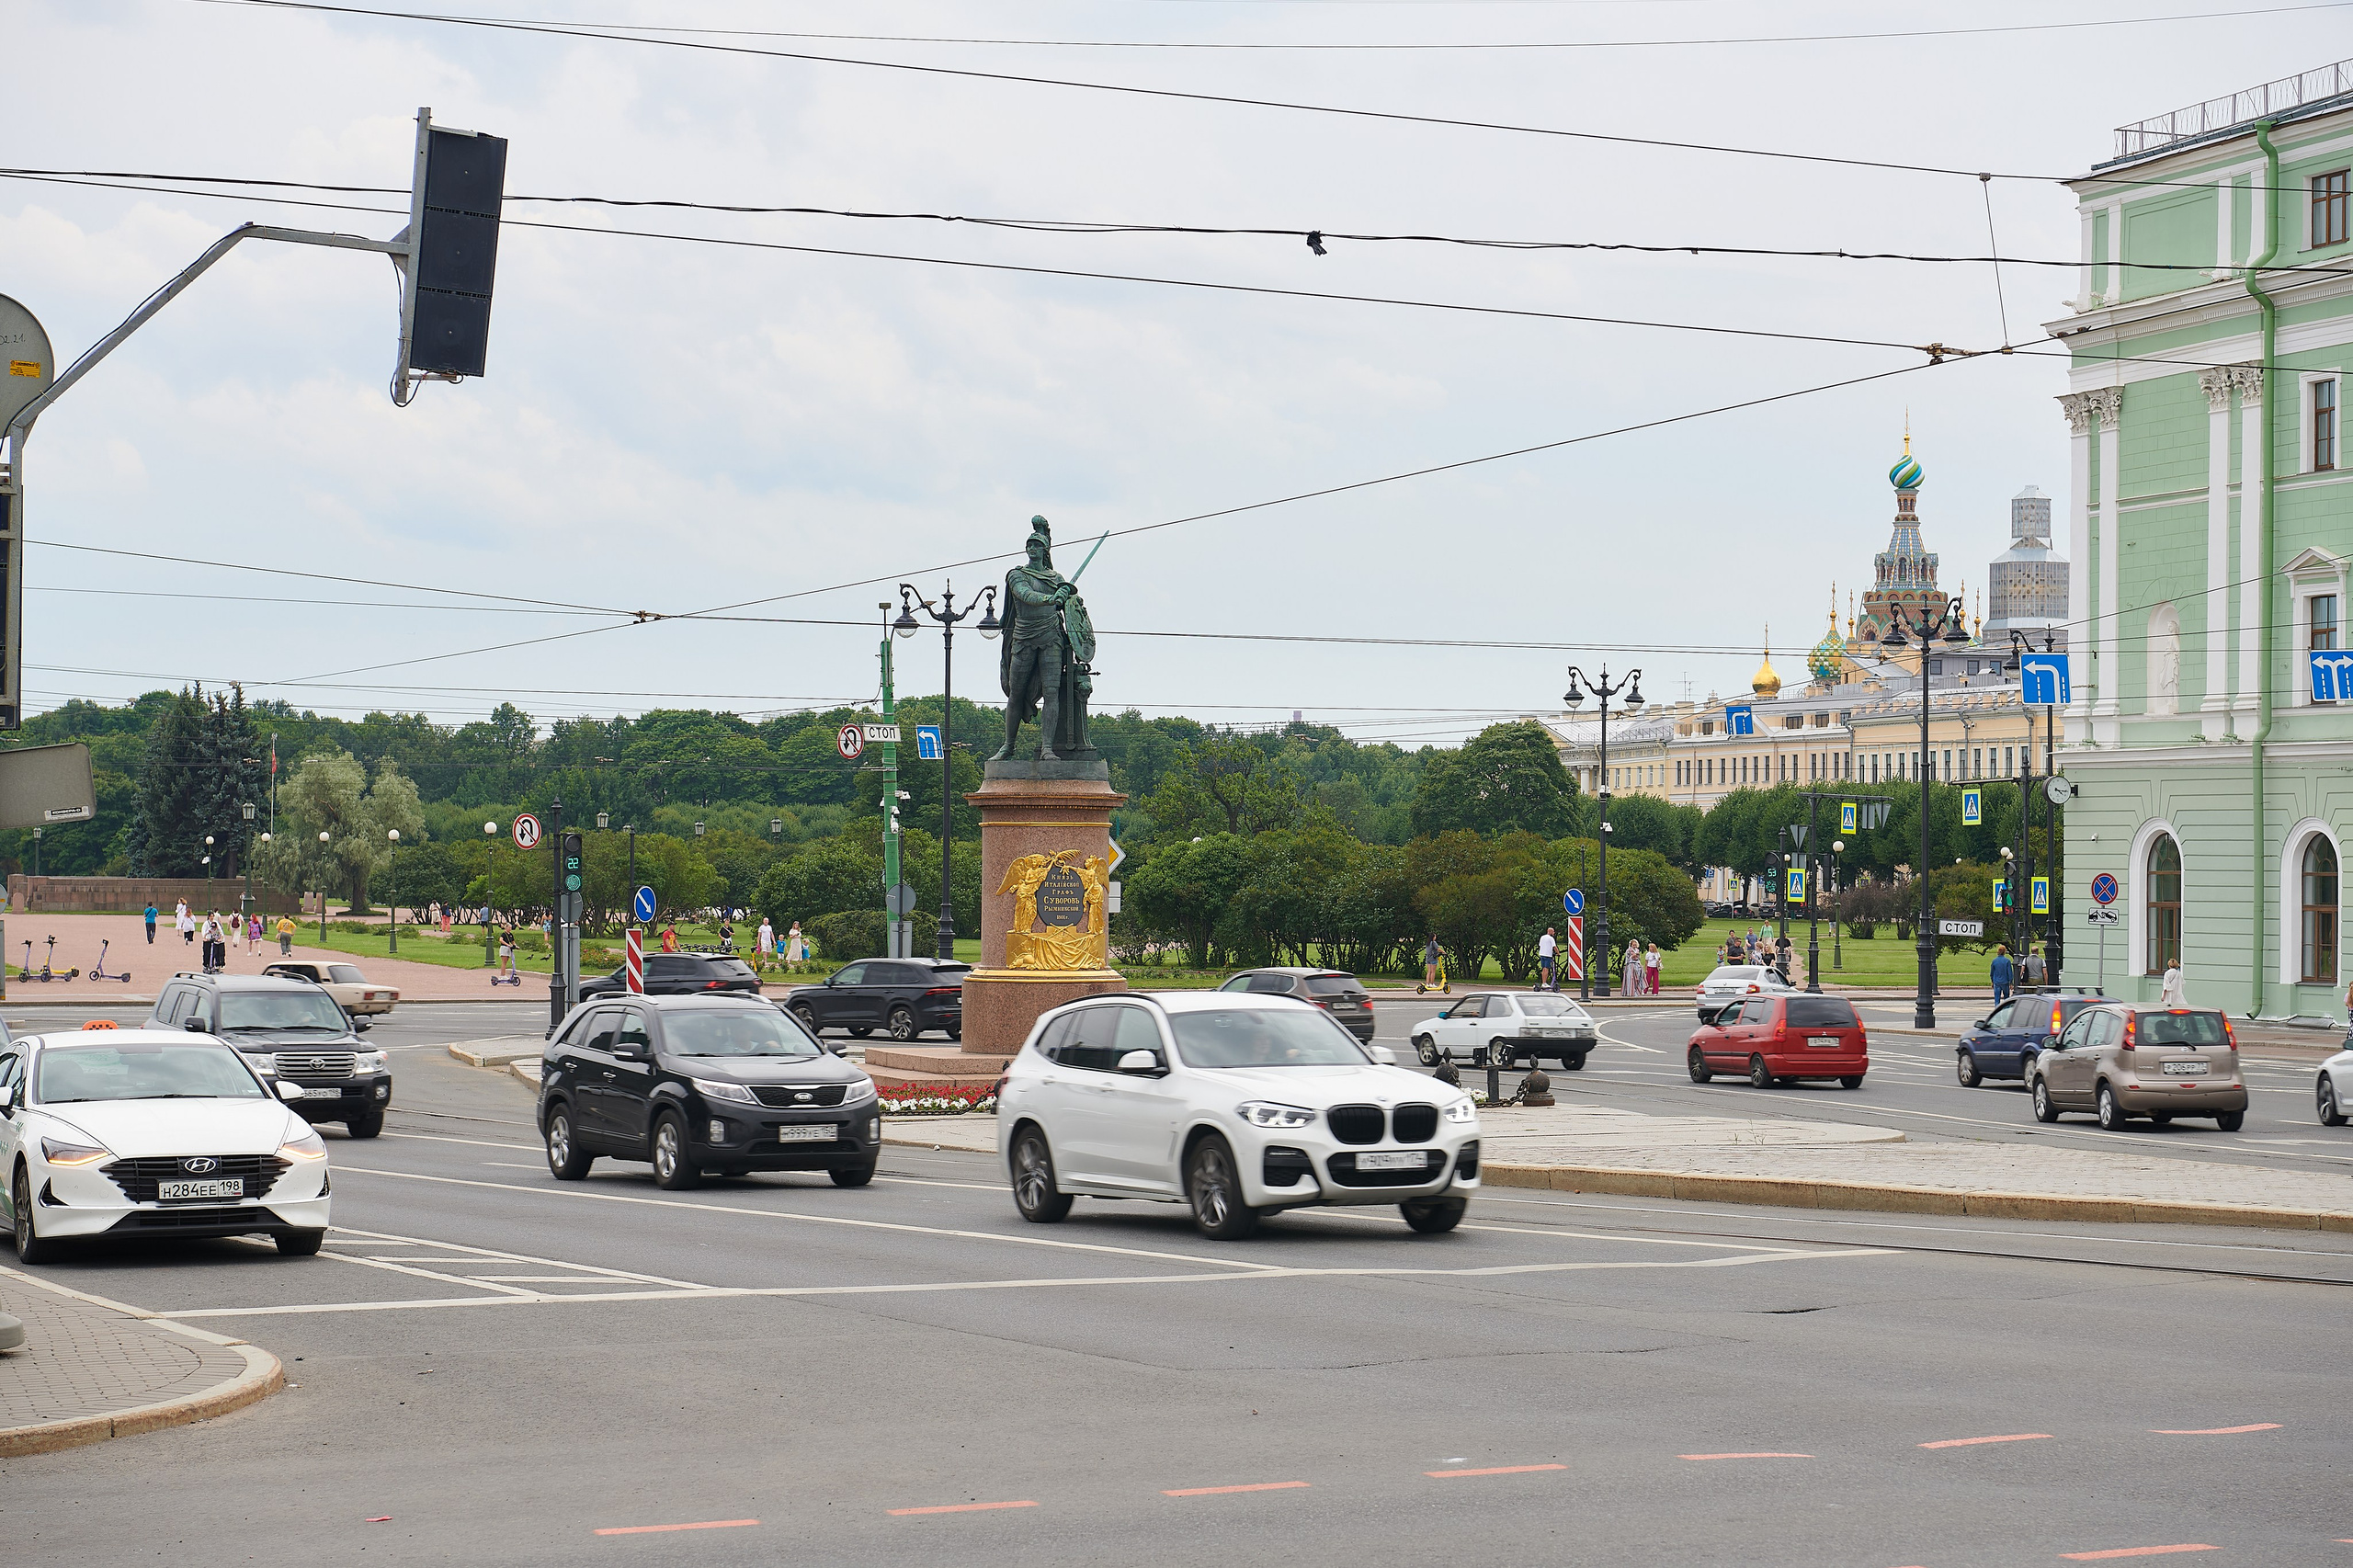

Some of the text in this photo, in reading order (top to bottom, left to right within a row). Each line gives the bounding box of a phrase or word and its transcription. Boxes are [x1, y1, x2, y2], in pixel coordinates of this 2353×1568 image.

[869, 726, 896, 739] СТОП
[567, 857, 579, 869] 22
[1768, 868, 1777, 877] 53
[1043, 895, 1080, 904] СУВОРОВЪ
[1945, 922, 1977, 934] СТОП
[163, 1180, 240, 1198] Н284ЕЕ 198
